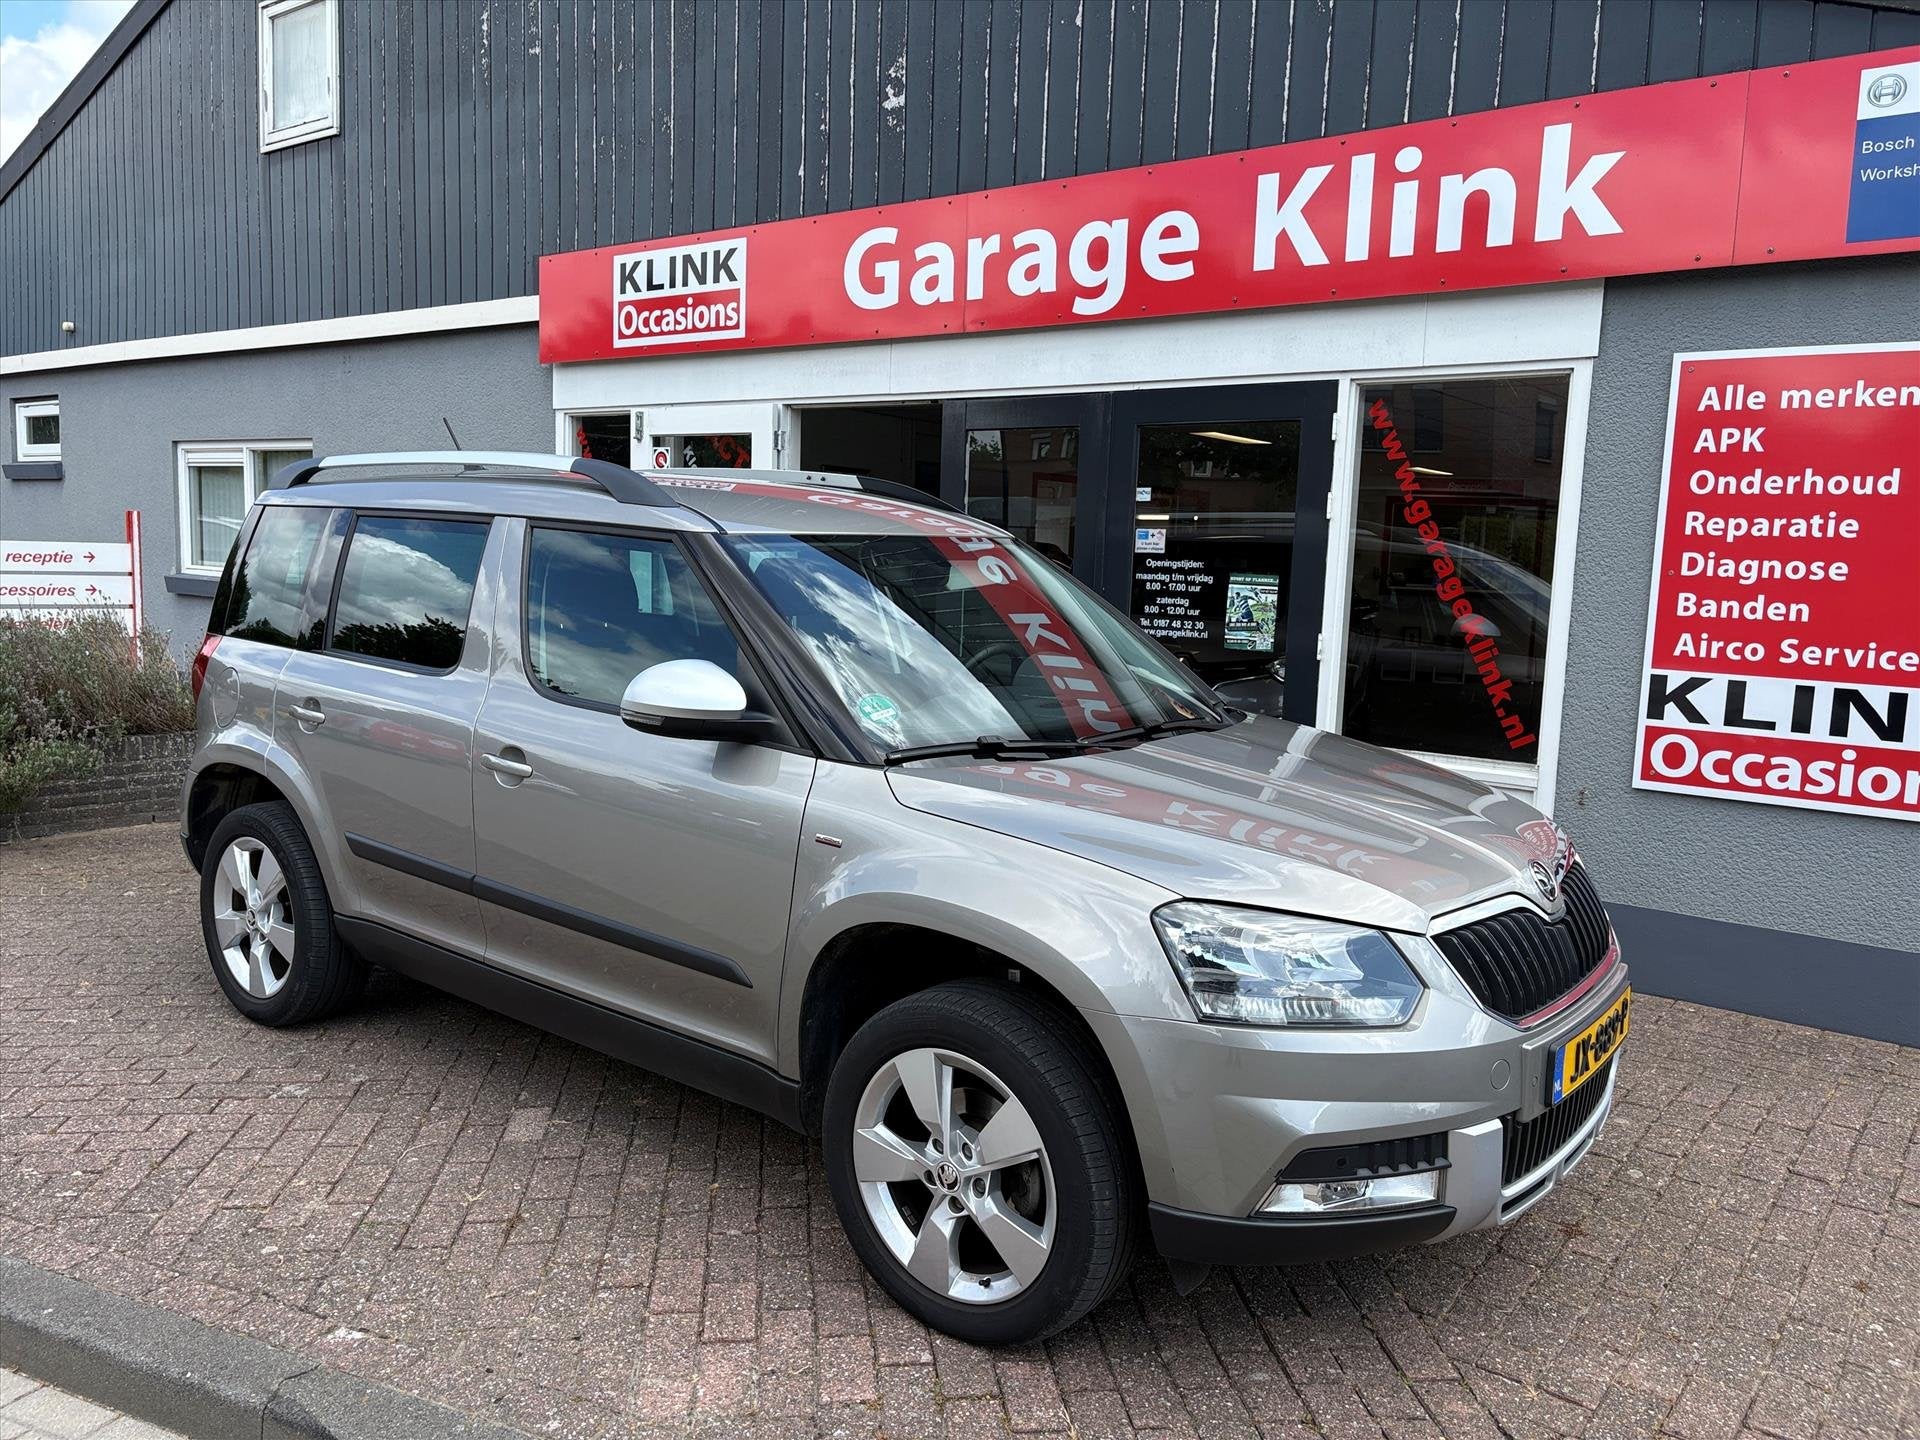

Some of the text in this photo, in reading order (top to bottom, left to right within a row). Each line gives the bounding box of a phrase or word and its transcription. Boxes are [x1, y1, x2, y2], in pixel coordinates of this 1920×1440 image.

[1862, 136, 1915, 153] Bosch
[843, 122, 1625, 316] Garage Klink
[619, 247, 738, 295] KLINK
[619, 296, 738, 336] Occasions
[1697, 379, 1920, 412] Alle merken
[1693, 426, 1766, 454] APK
[1689, 467, 1900, 496] Onderhoud
[1684, 511, 1860, 543] Reparatie
[5, 550, 74, 566] receptie
[1146, 558, 1204, 570] Openingstijden:
[1681, 552, 1848, 586] Diagnose
[1135, 572, 1214, 584] maandag t/m vrijdag
[1145, 582, 1161, 590] 8.00
[1168, 583, 1186, 591] 17.00
[1368, 399, 1537, 750] www.garageklink.nl
[0, 583, 77, 597] cessoires
[1156, 597, 1190, 607] zaterdag
[1144, 605, 1159, 614] 9.00
[1167, 606, 1185, 615] 12.00
[1676, 593, 1810, 623] Banden
[1140, 618, 1205, 630] Tel. 0187 48 32 30
[1673, 632, 1920, 672] Airco Service
[1646, 673, 1909, 743] KLIN
